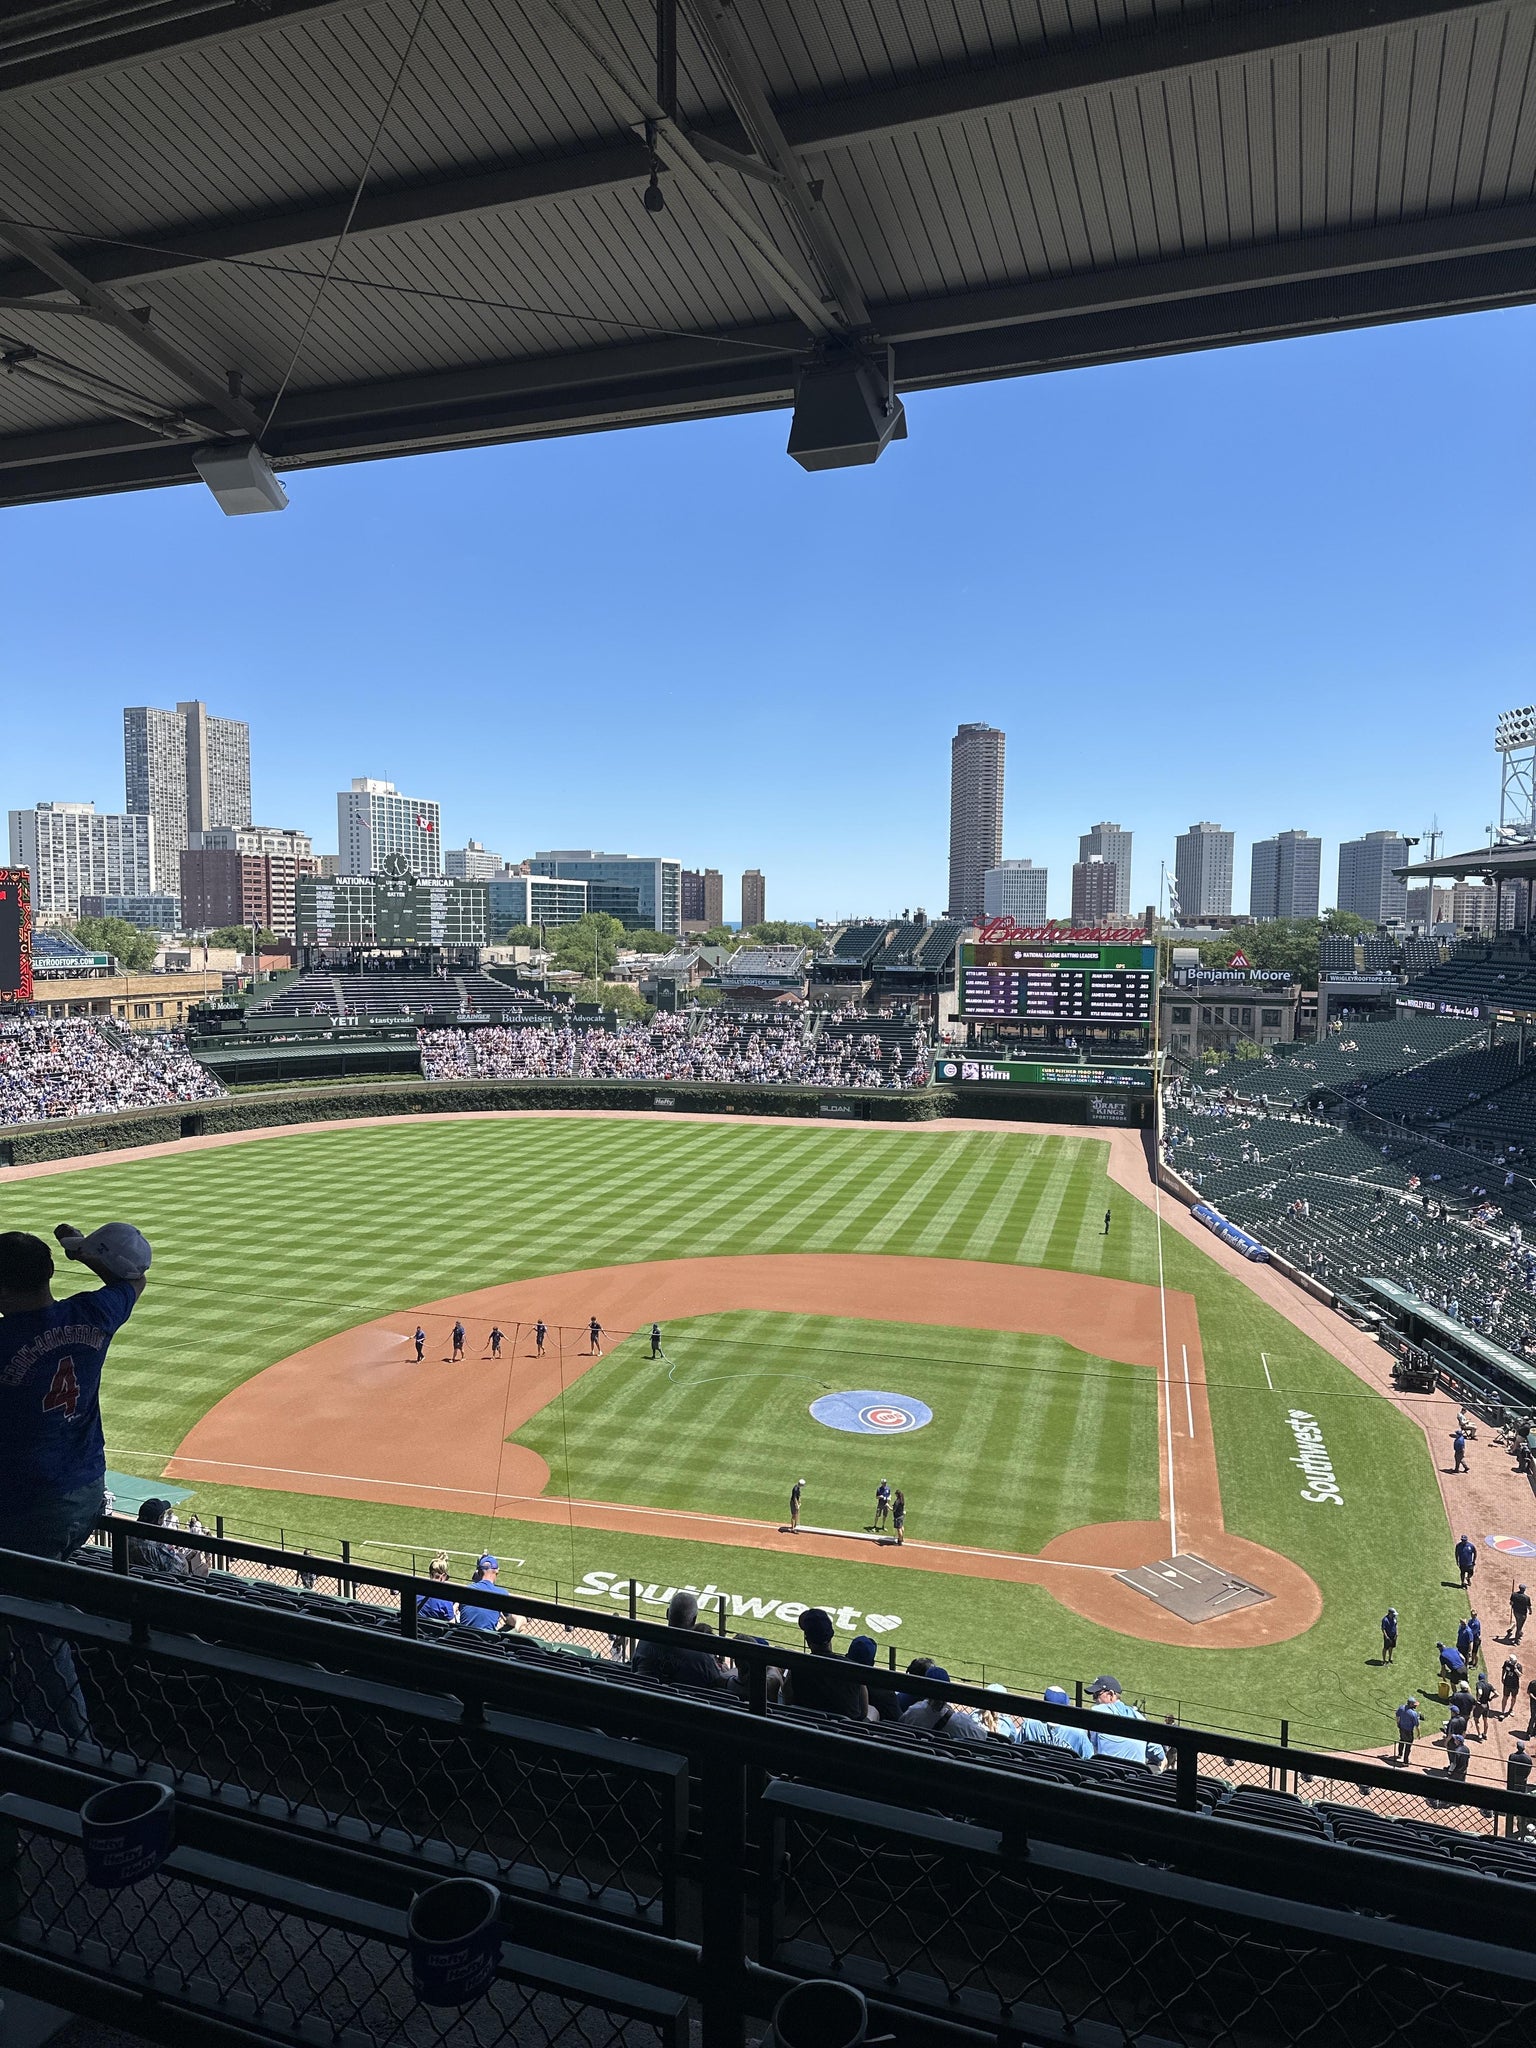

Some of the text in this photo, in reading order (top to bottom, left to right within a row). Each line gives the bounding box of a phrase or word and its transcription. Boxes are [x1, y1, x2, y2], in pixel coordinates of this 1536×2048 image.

[336, 877, 376, 885] NATIONAL
[416, 879, 454, 887] AMERICAN
[973, 916, 1147, 943] Budweiser
[1188, 968, 1291, 982] Benjamin Moore
[330, 1016, 359, 1027] YETI
[375, 1015, 414, 1025] tastytrade
[502, 1013, 553, 1023] Budweiser
[573, 1014, 605, 1022] Advocate
[981, 1070, 1010, 1080] SMITH
[820, 1105, 850, 1113] SLOAN
[42, 1355, 80, 1418] 4
[1285, 1419, 1344, 1506] Southwest
